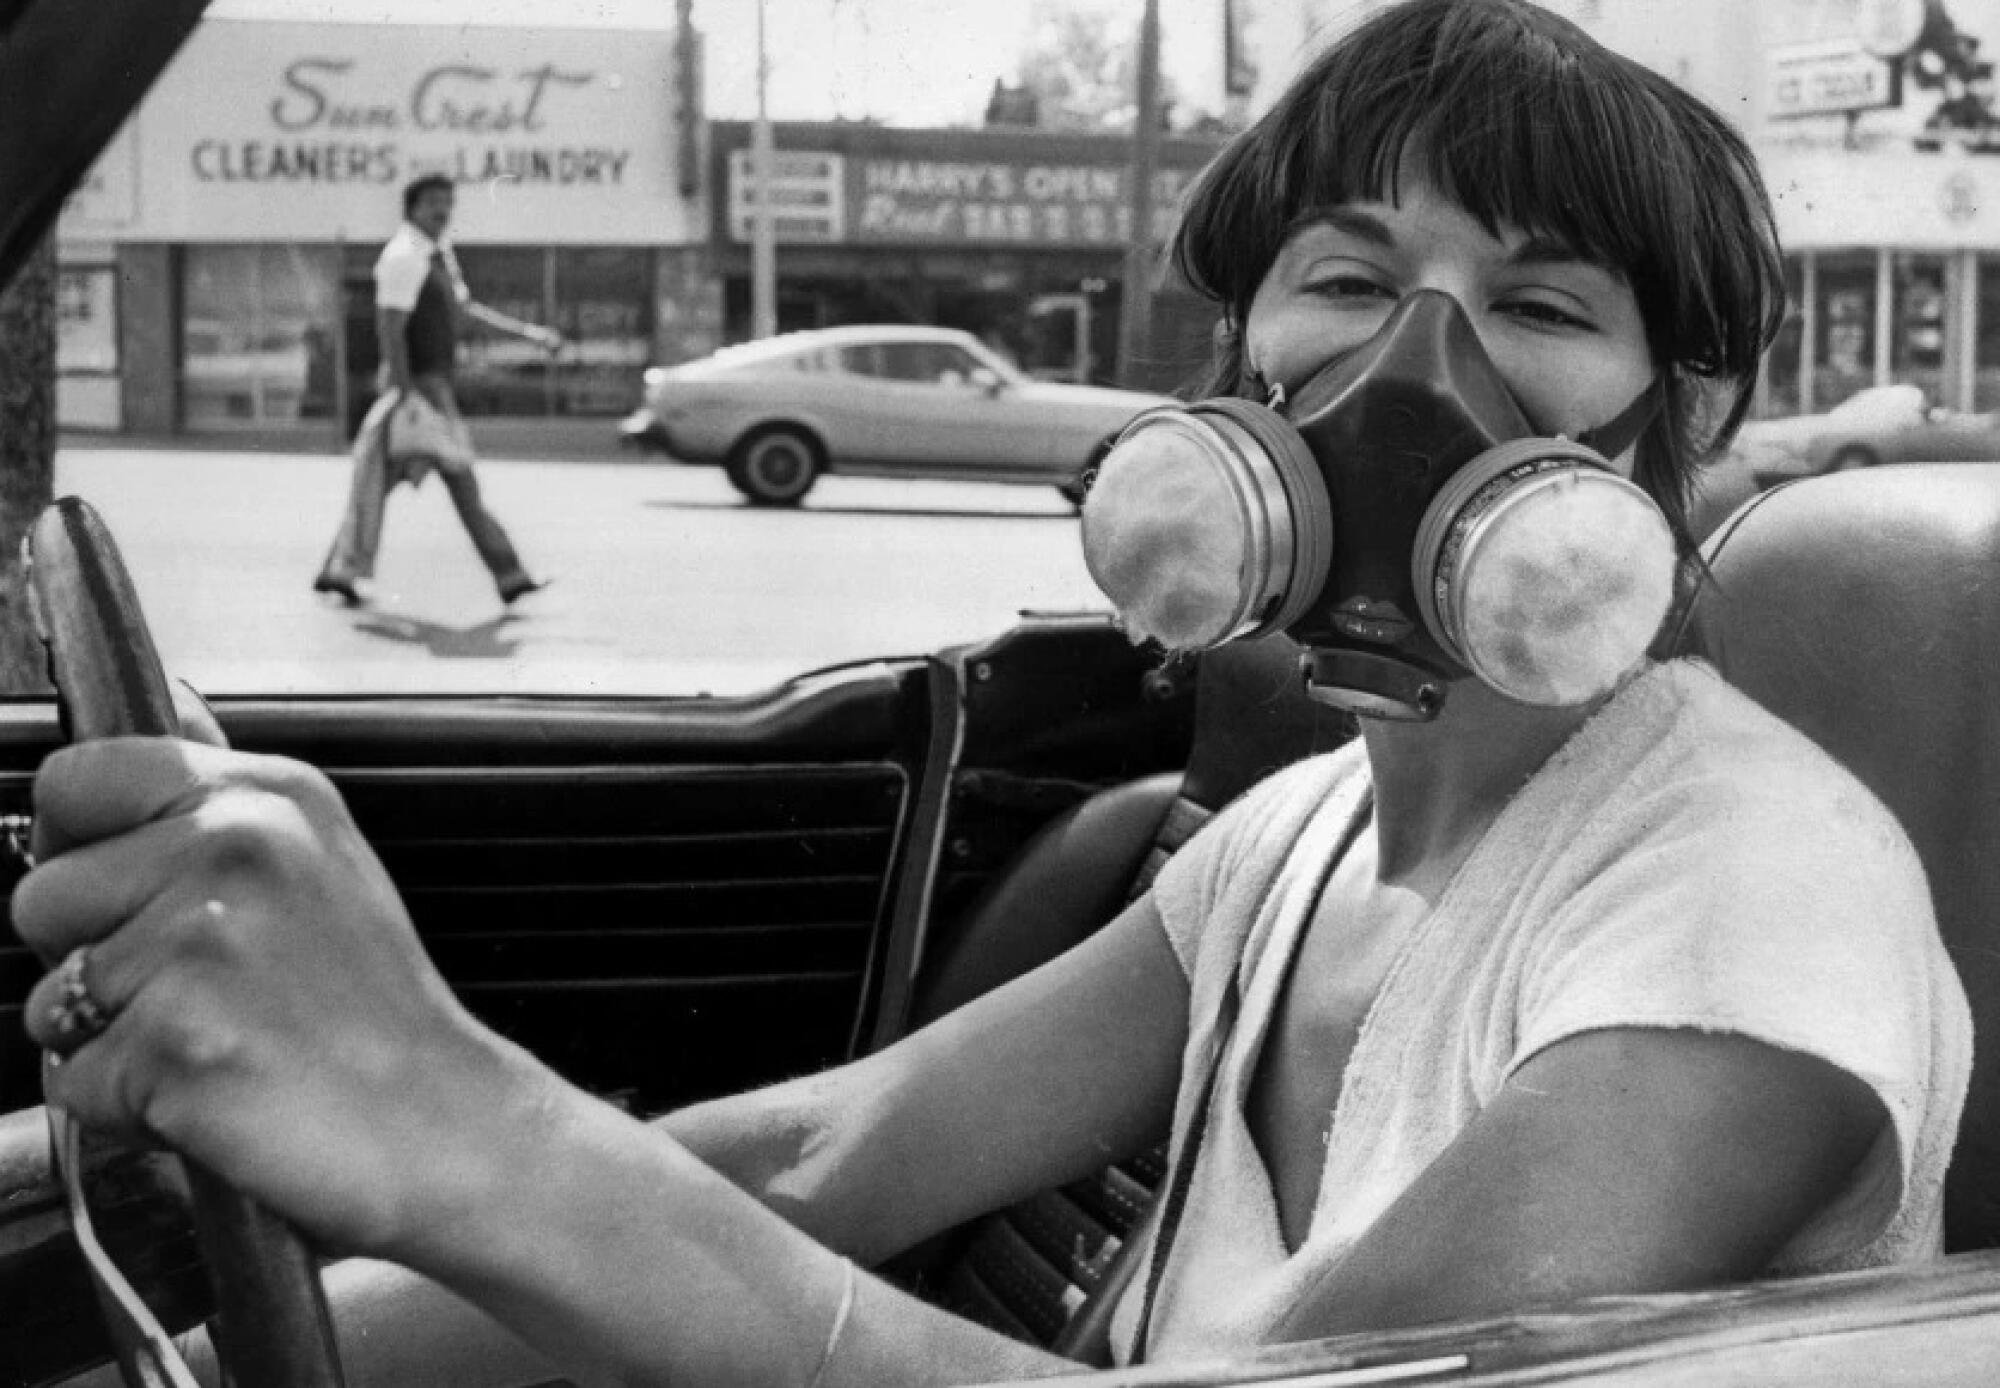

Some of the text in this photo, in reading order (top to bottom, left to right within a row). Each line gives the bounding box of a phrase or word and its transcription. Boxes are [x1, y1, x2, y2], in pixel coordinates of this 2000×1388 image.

[270, 58, 595, 134] Sun Crest
[190, 141, 397, 184] CLEANERS
[457, 145, 630, 185] LAUNDRY
[1023, 166, 1120, 200] OPEN
